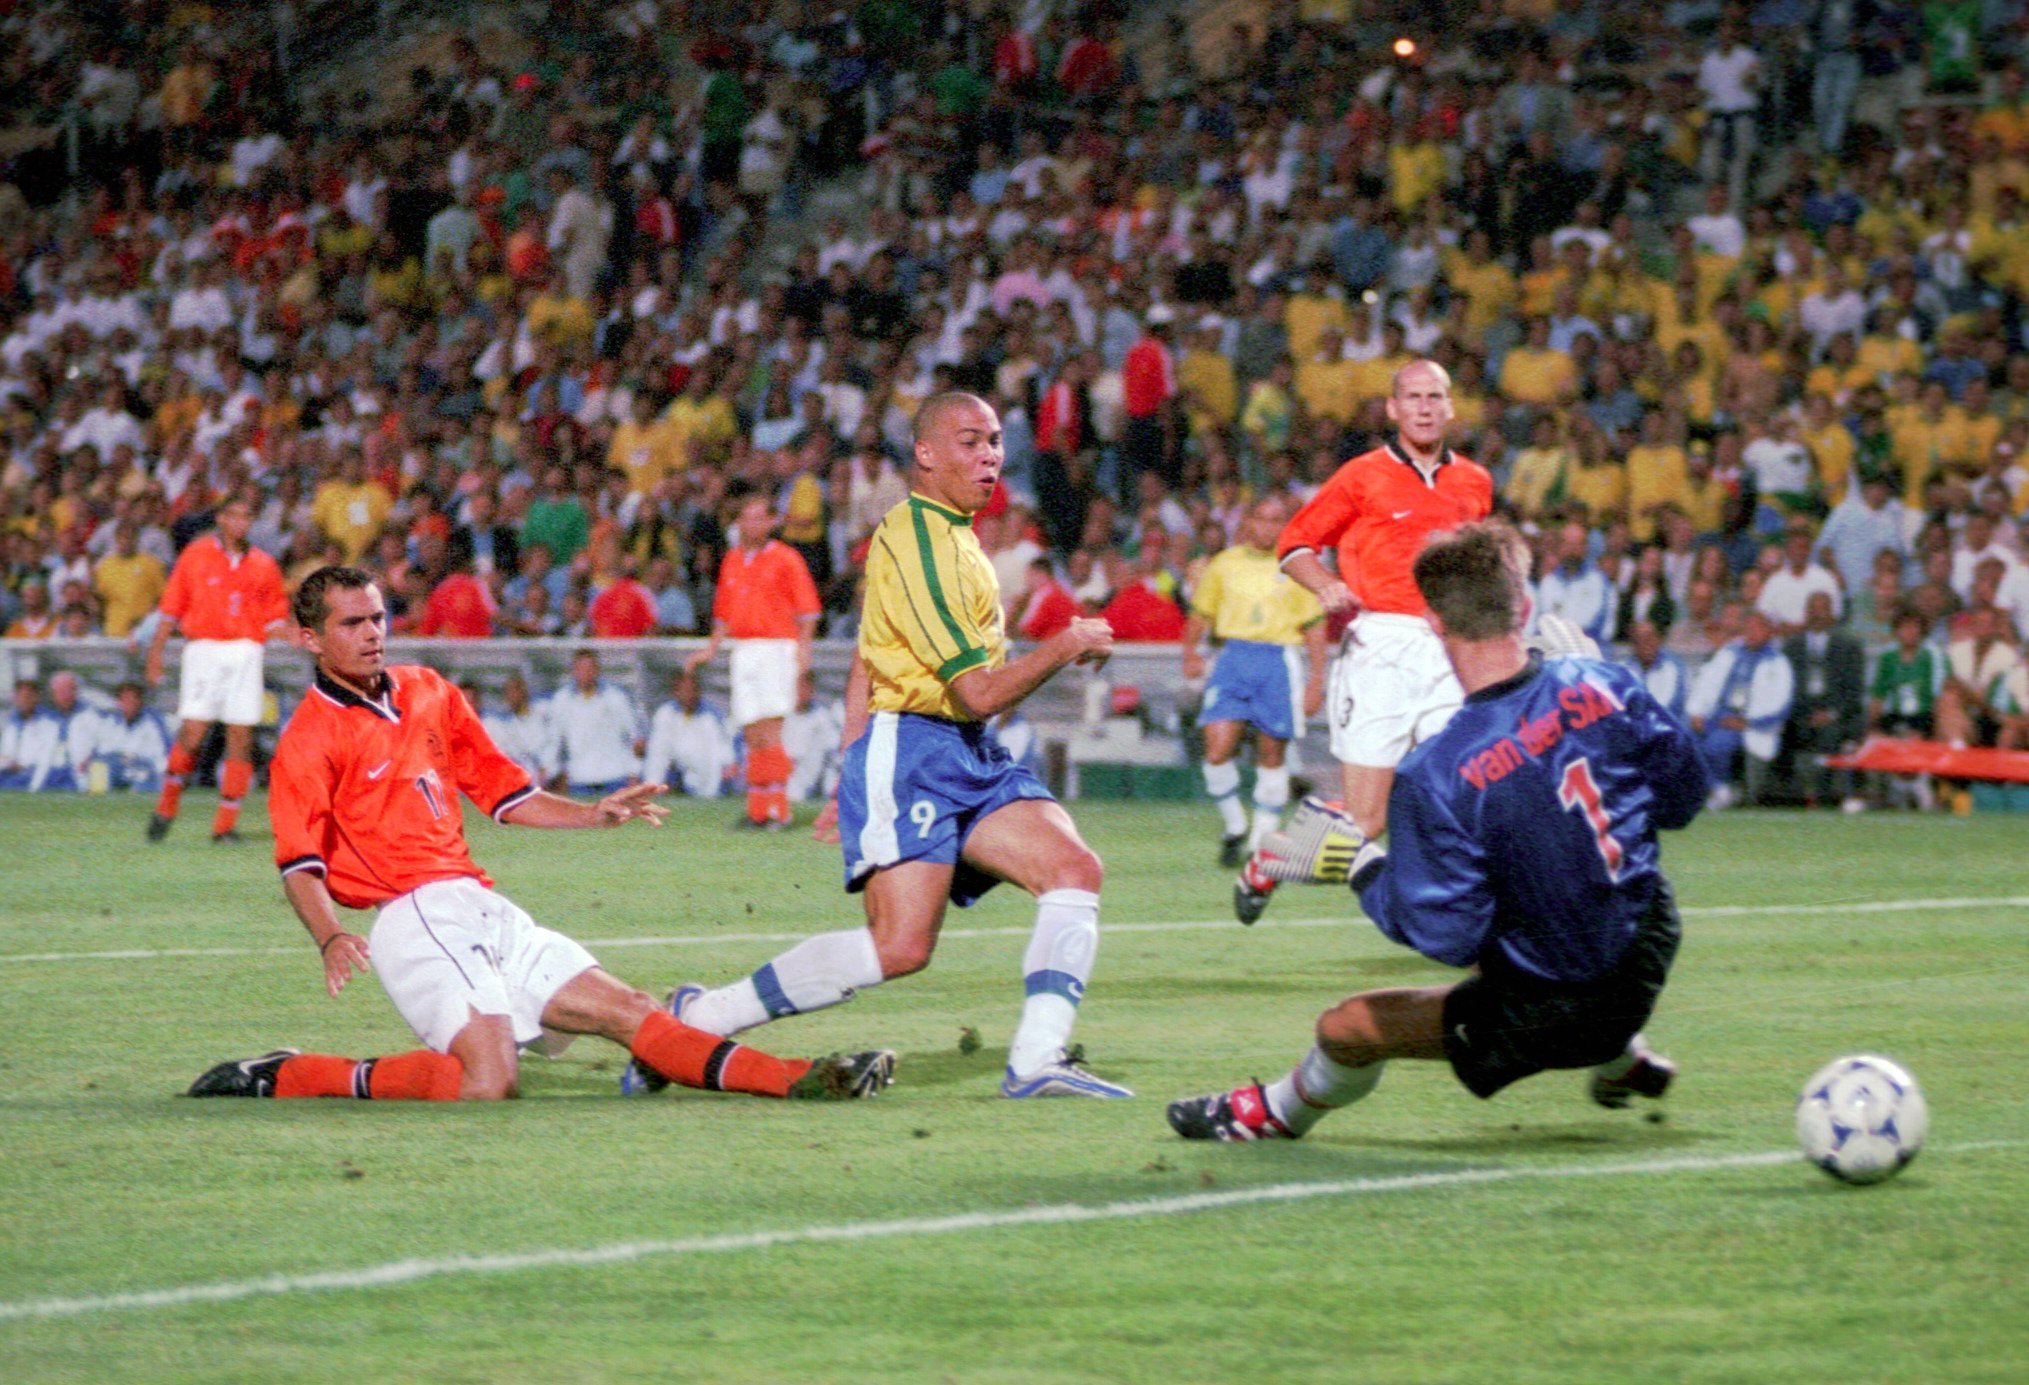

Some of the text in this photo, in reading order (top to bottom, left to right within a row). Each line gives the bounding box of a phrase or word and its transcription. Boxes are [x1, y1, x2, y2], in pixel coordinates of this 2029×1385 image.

[1459, 738, 1524, 790] van
[910, 800, 936, 839] 9
[1556, 757, 1622, 884] 1
